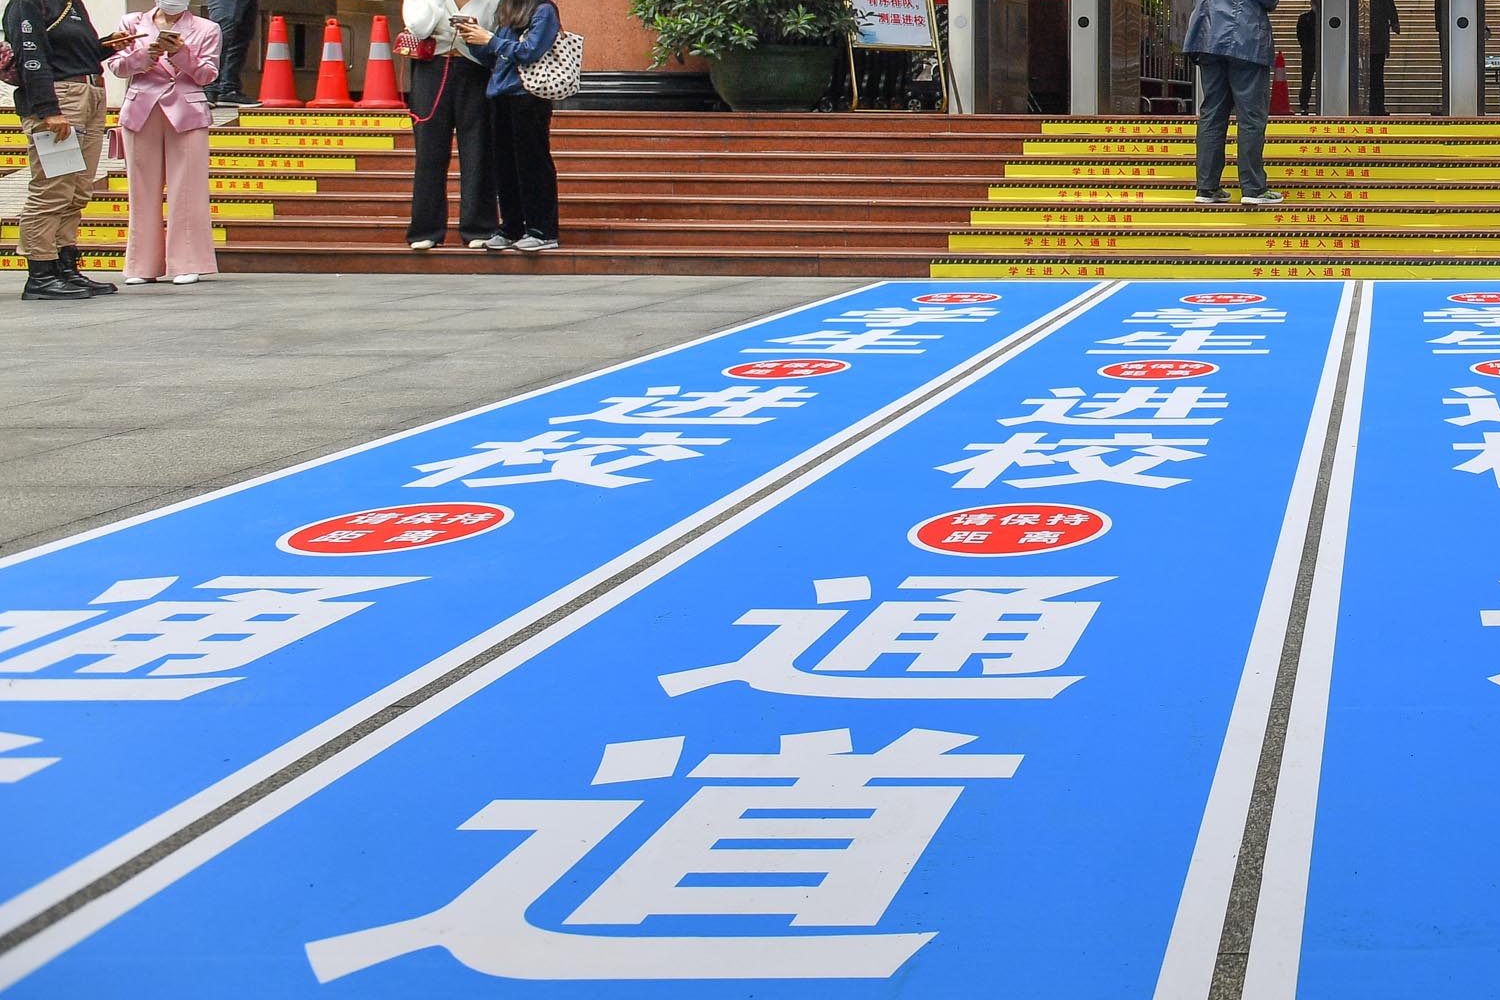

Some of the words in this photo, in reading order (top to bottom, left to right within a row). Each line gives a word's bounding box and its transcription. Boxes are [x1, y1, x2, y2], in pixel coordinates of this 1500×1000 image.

[878, 12, 927, 27] 测温进校
[1104, 126, 1183, 135] 学生进入通道
[1310, 126, 1388, 135] 学生进入通道
[1088, 144, 1169, 154] 学生进入通道
[1299, 145, 1381, 154] 学生进入通道
[1072, 167, 1156, 177] 学生进入通道
[1285, 168, 1370, 178] 学生进入通道
[1058, 190, 1145, 200] 学生进入通道
[1043, 213, 1133, 223] 学生进入通道
[1274, 213, 1366, 224] 学生进入通道
[1024, 237, 1117, 248] 学生进入通道
[1266, 239, 1361, 249] 学生进入通道
[1008, 266, 1106, 277] 学生进入通道
[1253, 267, 1352, 277] 学生进入通道
[401, 385, 819, 489] 进校
[932, 386, 1230, 489] 进校
[304, 575, 1120, 984] 通道
